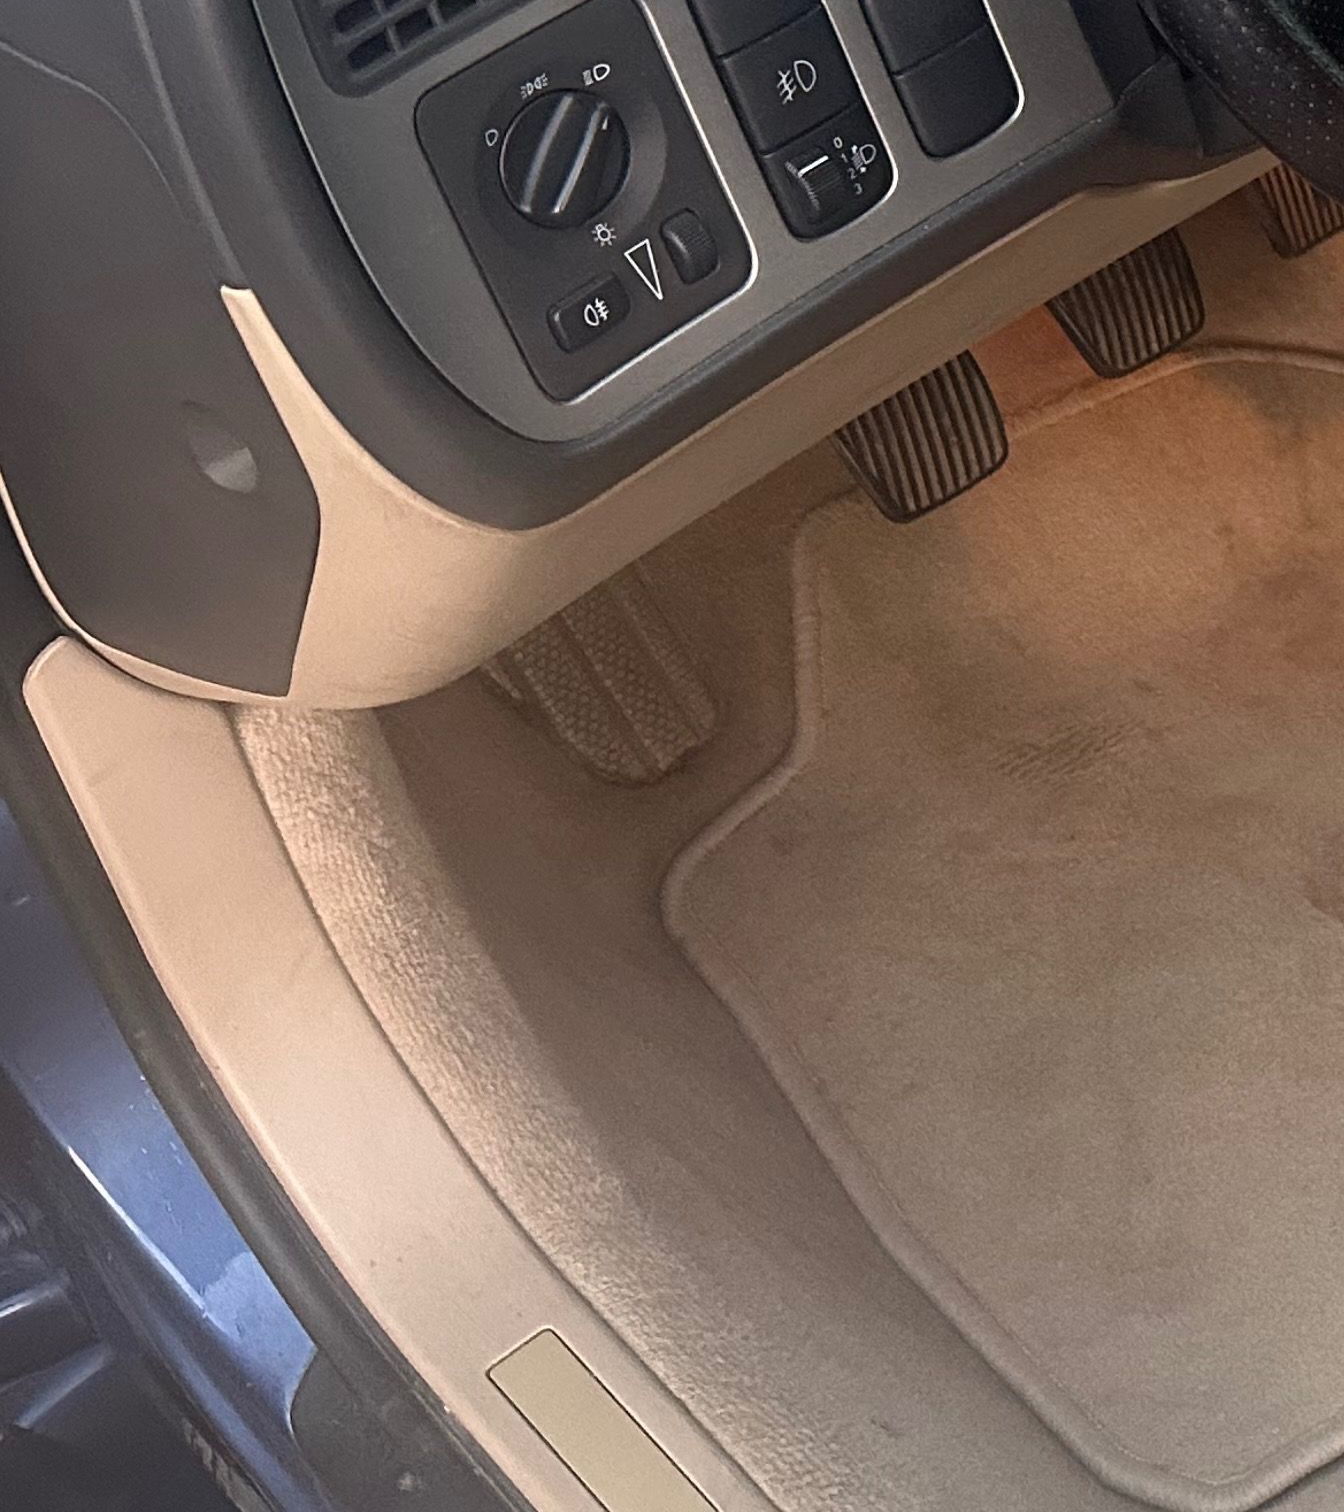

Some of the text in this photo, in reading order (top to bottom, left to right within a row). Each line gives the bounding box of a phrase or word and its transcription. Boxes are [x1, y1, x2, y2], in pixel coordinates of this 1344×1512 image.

[833, 136, 843, 149] 0
[847, 167, 858, 180] 2
[854, 183, 863, 195] 3
